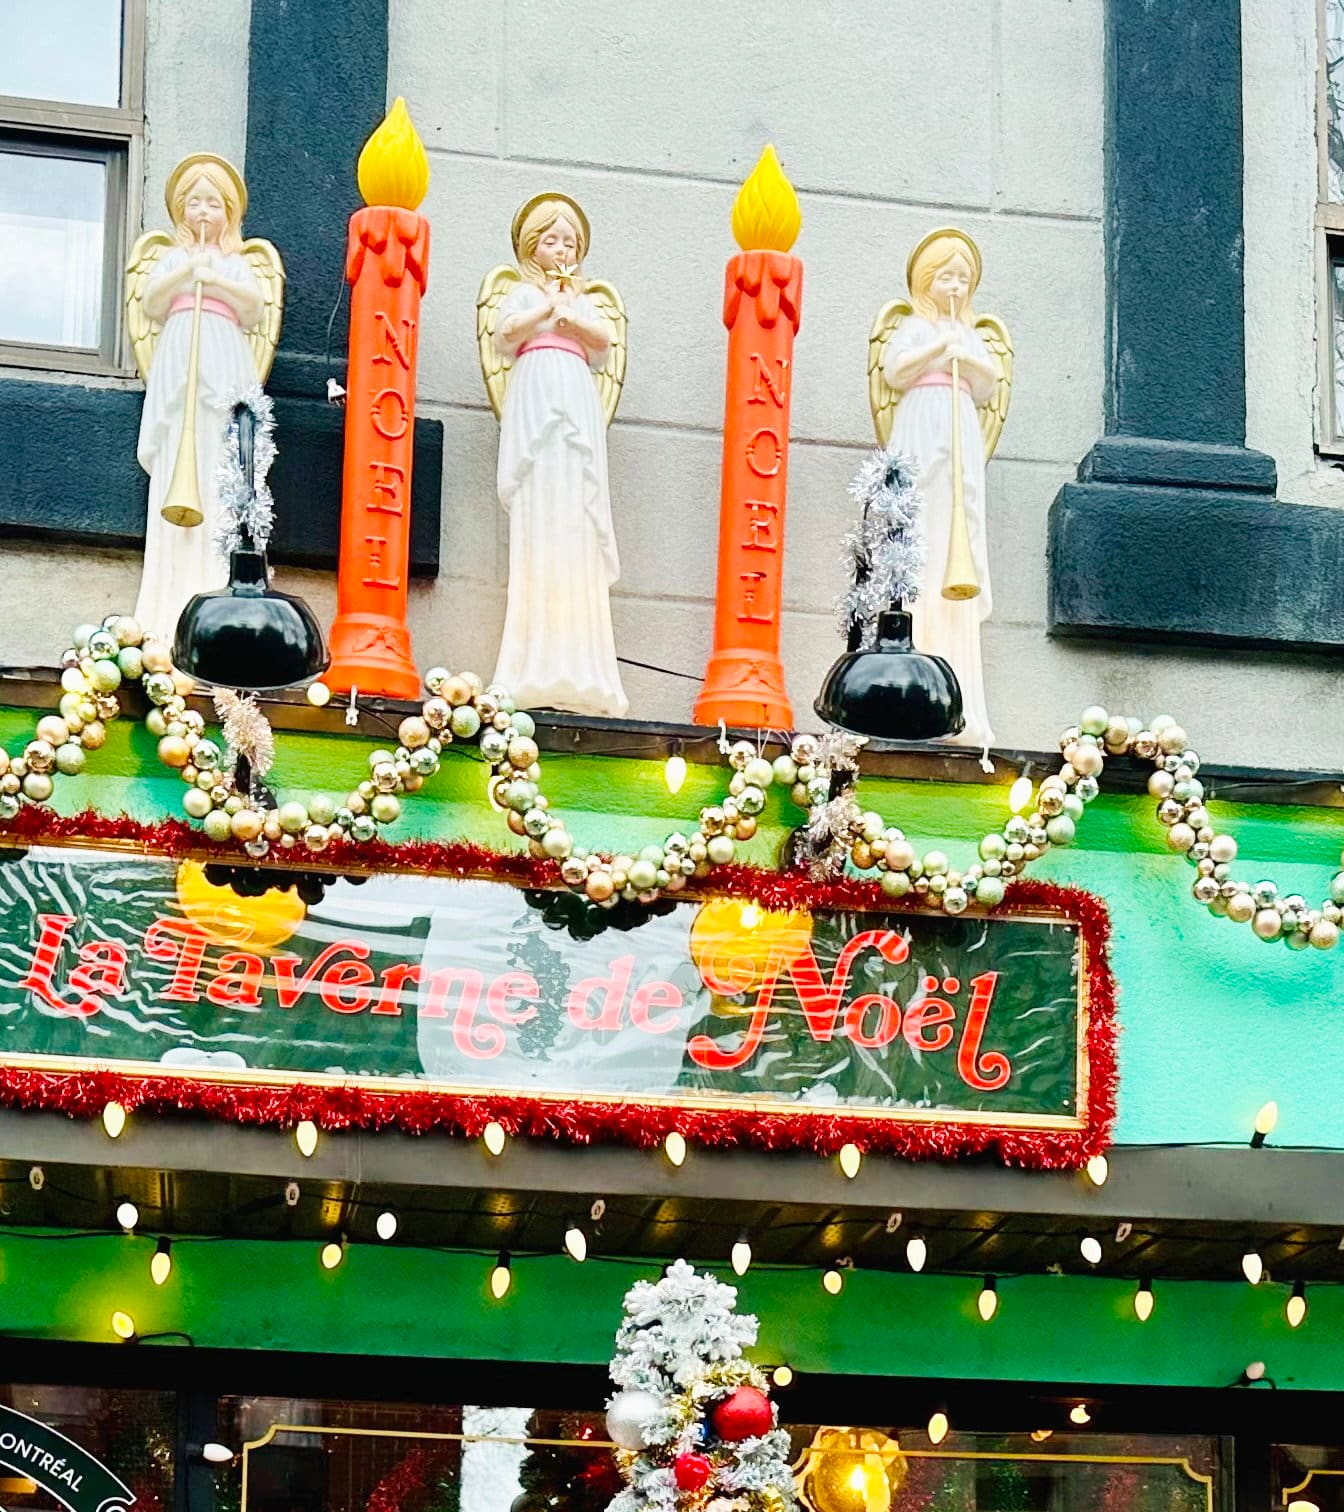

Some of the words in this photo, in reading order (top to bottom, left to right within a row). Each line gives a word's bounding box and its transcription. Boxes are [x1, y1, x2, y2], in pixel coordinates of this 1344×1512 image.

[363, 311, 416, 591] NOEL
[737, 353, 791, 624] NOEL
[18, 913, 133, 1018] La
[144, 906, 541, 1060] Taverne
[566, 954, 683, 1034] de
[688, 929, 1012, 1091] Noël
